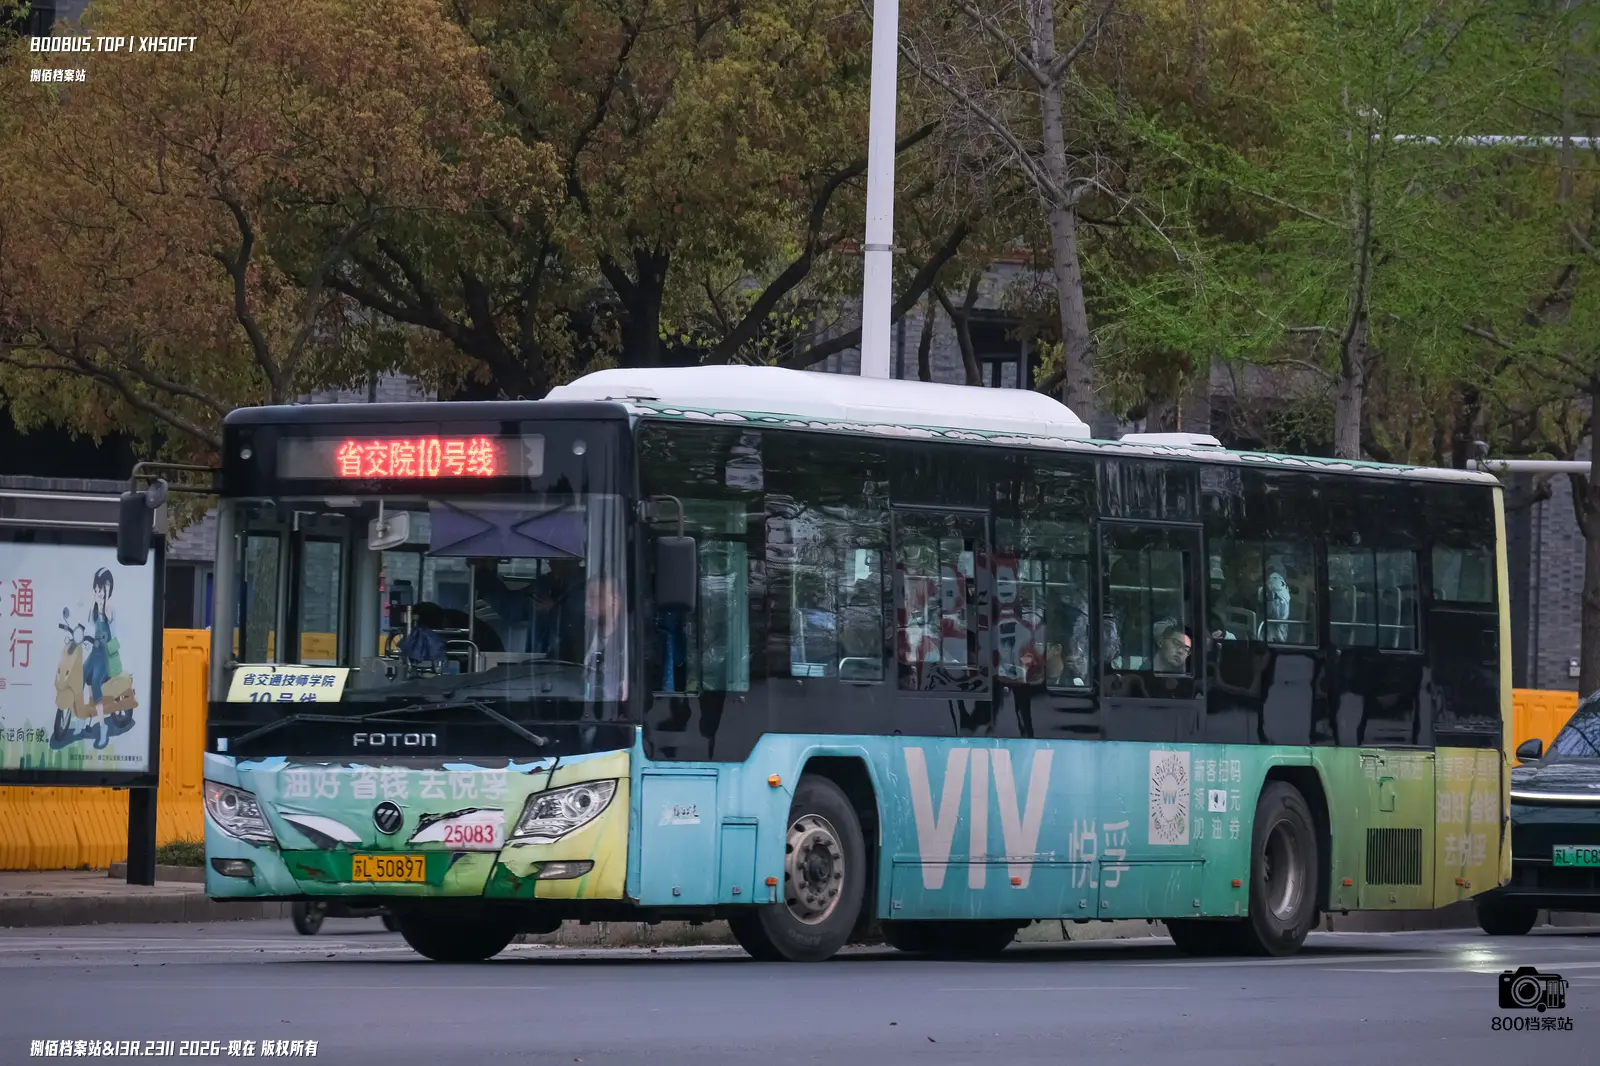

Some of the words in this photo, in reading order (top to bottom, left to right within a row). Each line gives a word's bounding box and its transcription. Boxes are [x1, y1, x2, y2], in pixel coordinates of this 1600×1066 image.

[337, 438, 494, 477] 省交院10号线
[0, 579, 34, 617] 通
[9, 628, 33, 668] 行
[243, 673, 336, 687] 省交通技师学院
[353, 732, 437, 747] FOTON
[351, 767, 409, 799] 省钱
[444, 824, 495, 844] 25083
[904, 747, 1054, 890] VIV
